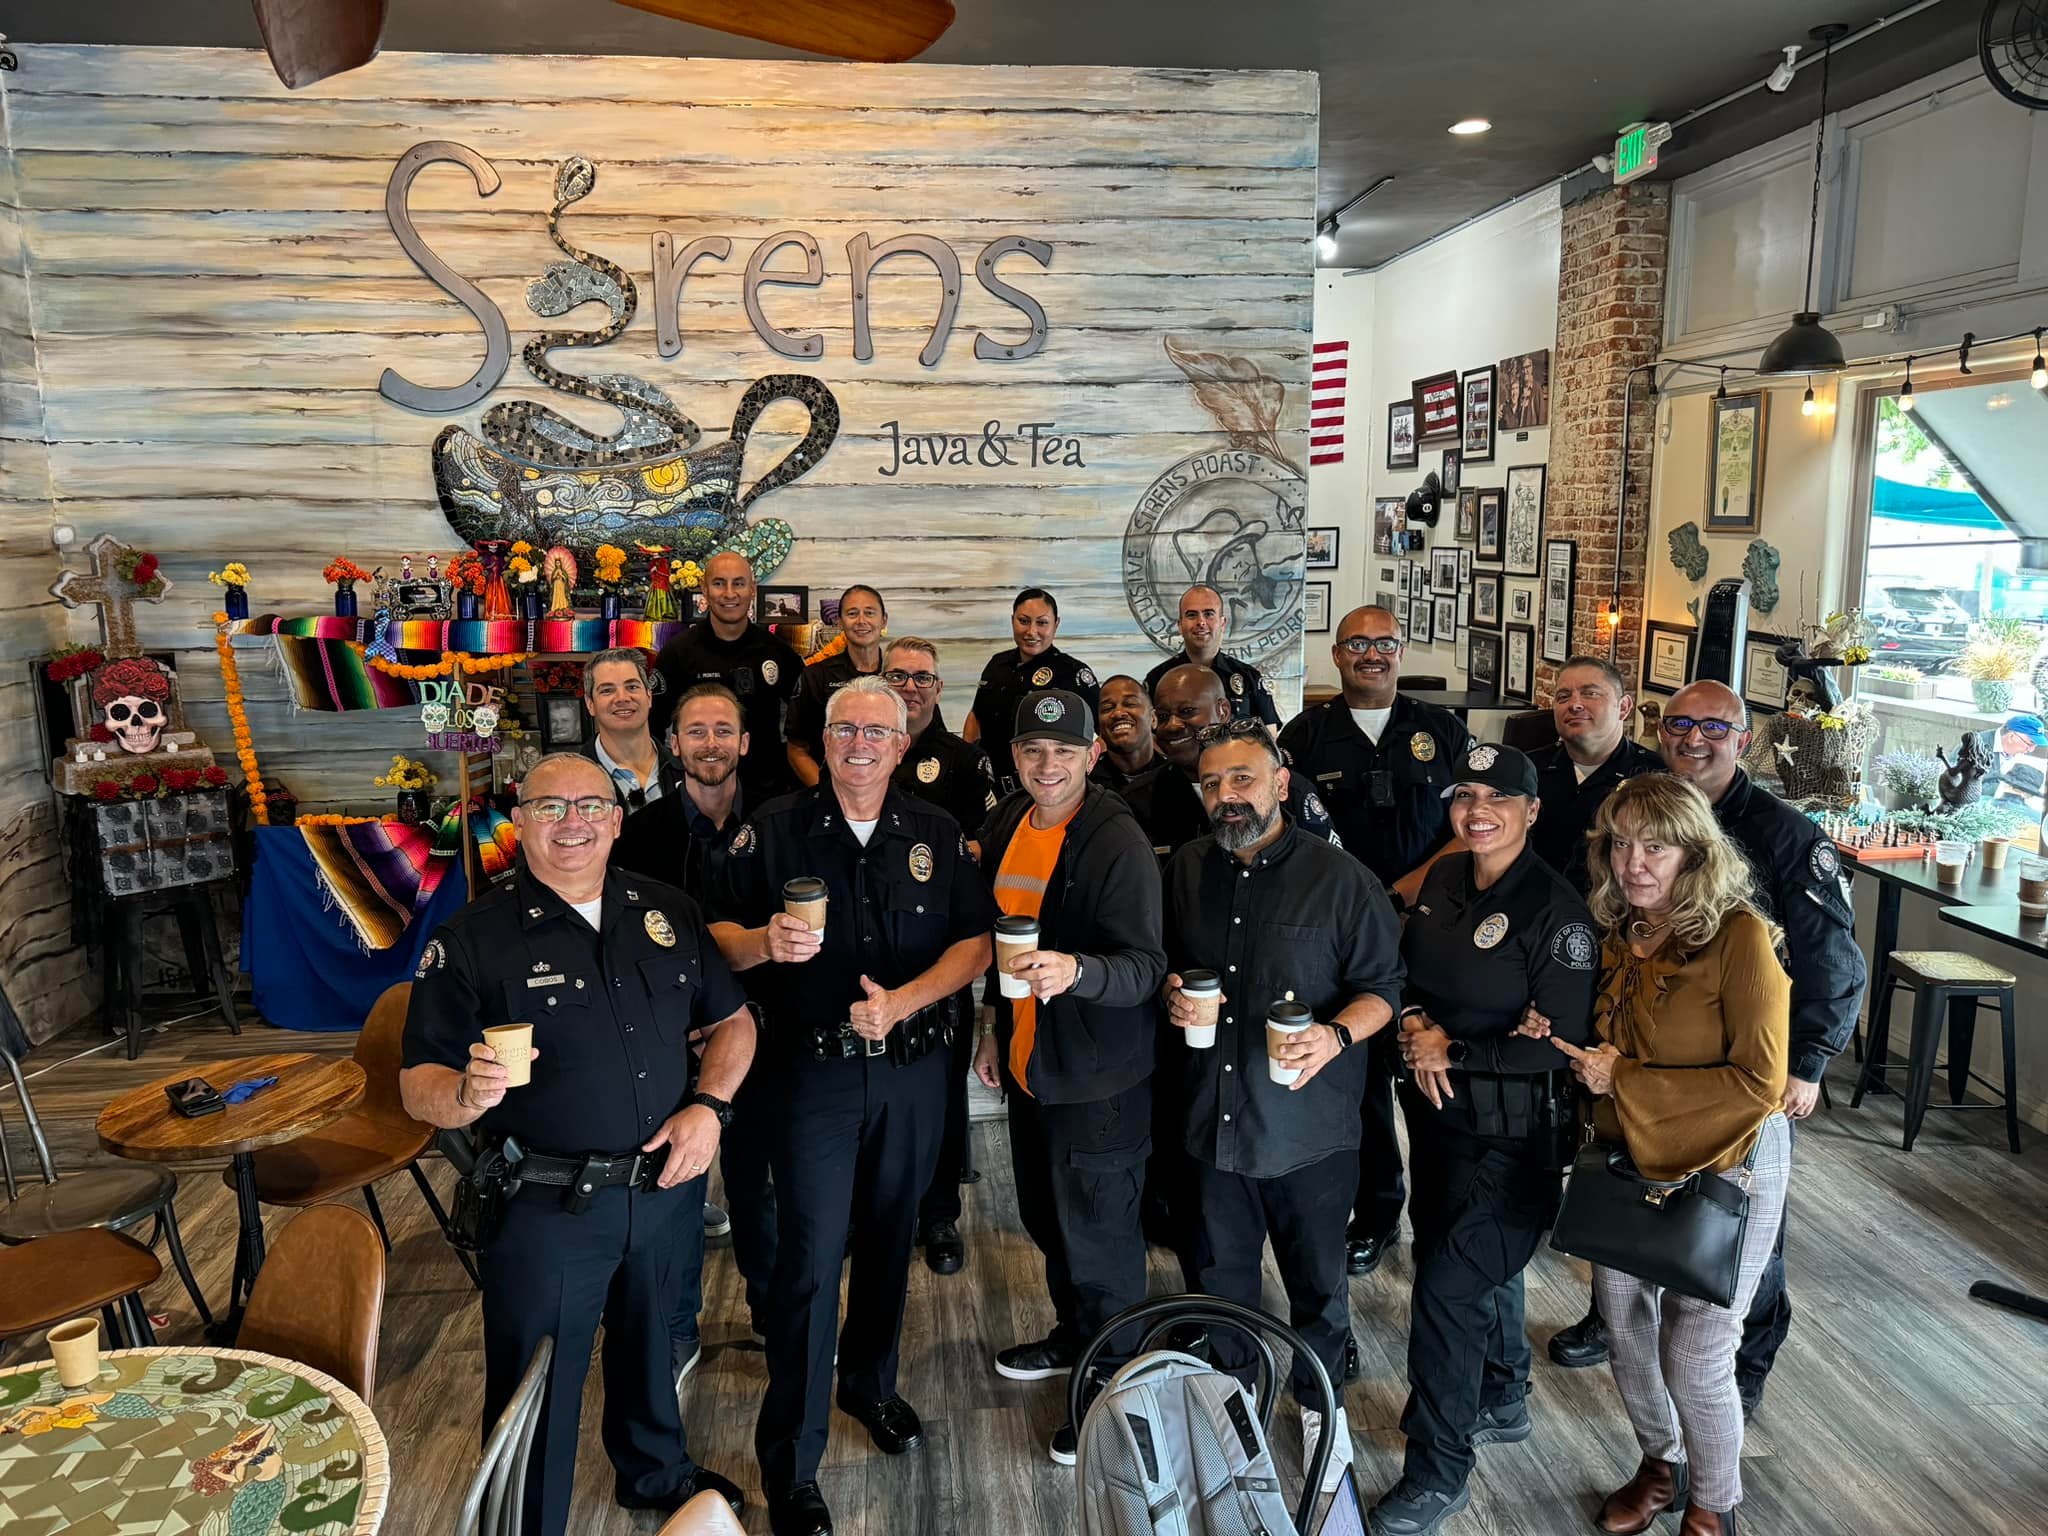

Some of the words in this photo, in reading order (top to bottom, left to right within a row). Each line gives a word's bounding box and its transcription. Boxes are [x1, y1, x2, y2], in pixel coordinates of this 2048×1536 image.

[879, 421, 971, 477] Java
[977, 420, 1017, 466] &
[1020, 421, 1086, 468] Tea
[1134, 472, 1188, 534] SIRENS
[1192, 452, 1261, 480] ROAST
[1224, 645, 1254, 660] AN
[418, 680, 466, 705] DIA
[446, 707, 475, 729] LOS
